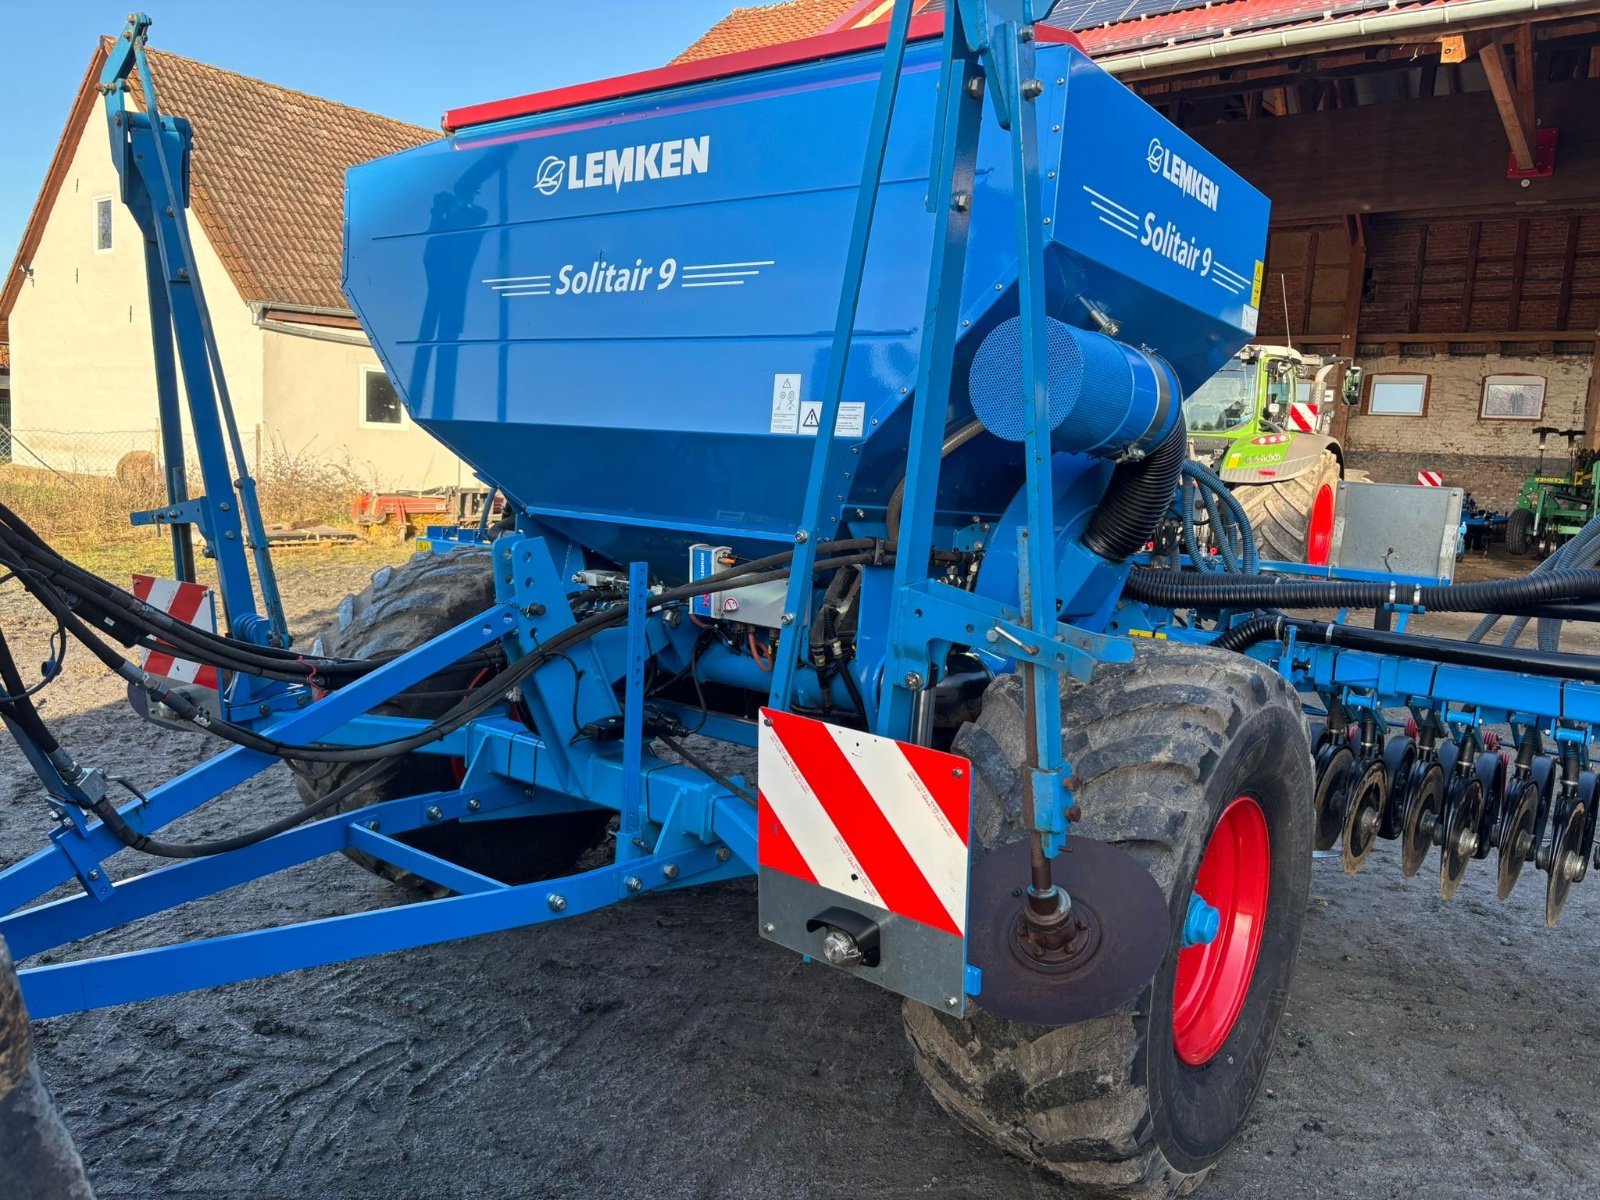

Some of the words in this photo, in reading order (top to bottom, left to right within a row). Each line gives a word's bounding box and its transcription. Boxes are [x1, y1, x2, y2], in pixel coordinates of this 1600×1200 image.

[567, 135, 710, 194] LEMKEN
[1162, 148, 1220, 212] LEMKEN
[1140, 211, 1201, 272] Solitair
[1200, 247, 1213, 277] 9
[555, 258, 653, 296] Solitair
[657, 257, 677, 291] 9
